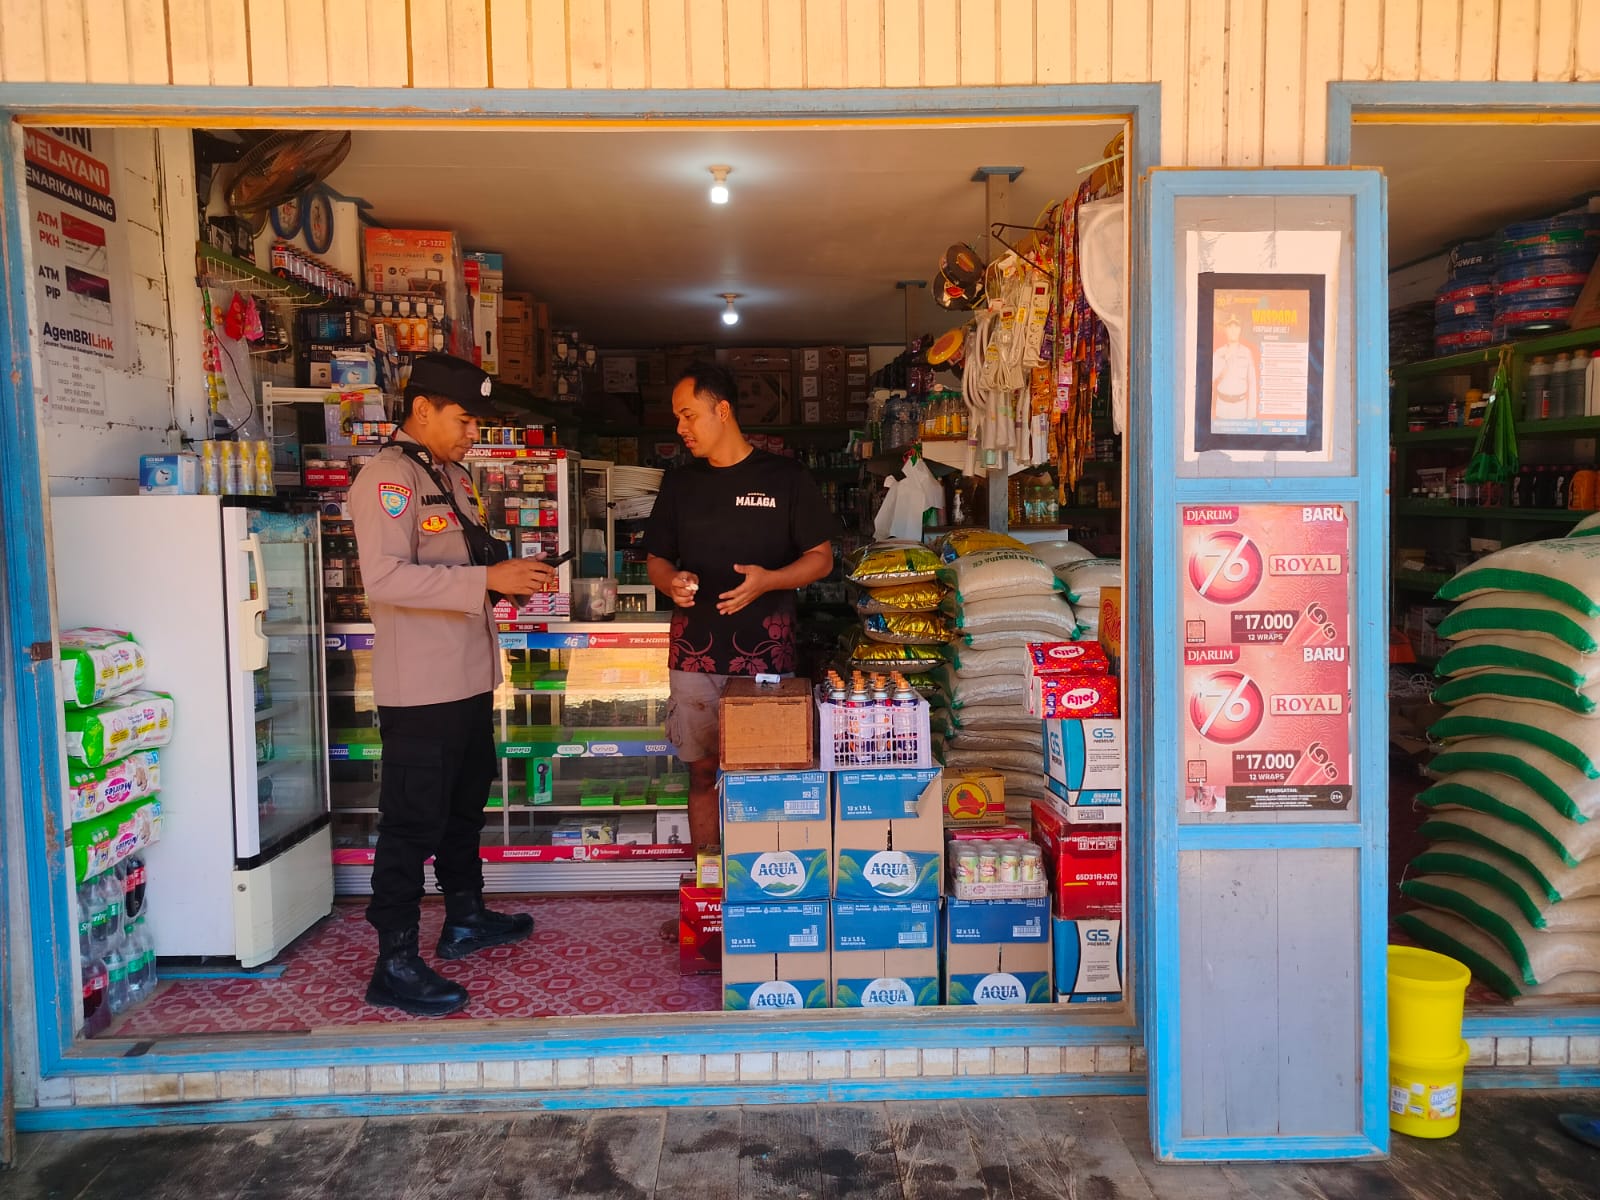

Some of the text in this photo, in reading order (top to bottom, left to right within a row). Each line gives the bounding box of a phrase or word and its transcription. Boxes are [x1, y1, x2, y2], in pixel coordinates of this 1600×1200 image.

[24, 133, 106, 188] MELAYANI
[84, 193, 113, 216] UANG
[37, 210, 58, 229] ATM
[39, 231, 60, 249] PKH
[38, 265, 60, 283] ATM
[45, 284, 61, 300] PIP
[43, 321, 114, 351] AgenBRILink
[1186, 510, 1233, 521] DJARUM
[1302, 507, 1344, 522] BARU
[1197, 535, 1250, 596] 76
[1274, 558, 1337, 572] ROYAL
[1244, 613, 1294, 630] 17.000
[563, 635, 579, 647] 4G
[1256, 633, 1284, 641] WRAPS
[1187, 649, 1234, 662] DJARUM
[1303, 648, 1345, 662] BARU
[1067, 692, 1095, 706] jolly
[1198, 675, 1251, 736] 76
[1276, 697, 1338, 712] ROYAL
[1092, 727, 1114, 739] GS
[1246, 753, 1295, 770] 17.000
[1258, 773, 1285, 781] WRAPS
[758, 862, 798, 878] AQUA
[871, 862, 910, 878] AQUA
[1086, 929, 1110, 941] GS
[869, 989, 908, 1005] AQUA
[980, 985, 1019, 1000] AQUA
[757, 993, 796, 1008] AQUA
